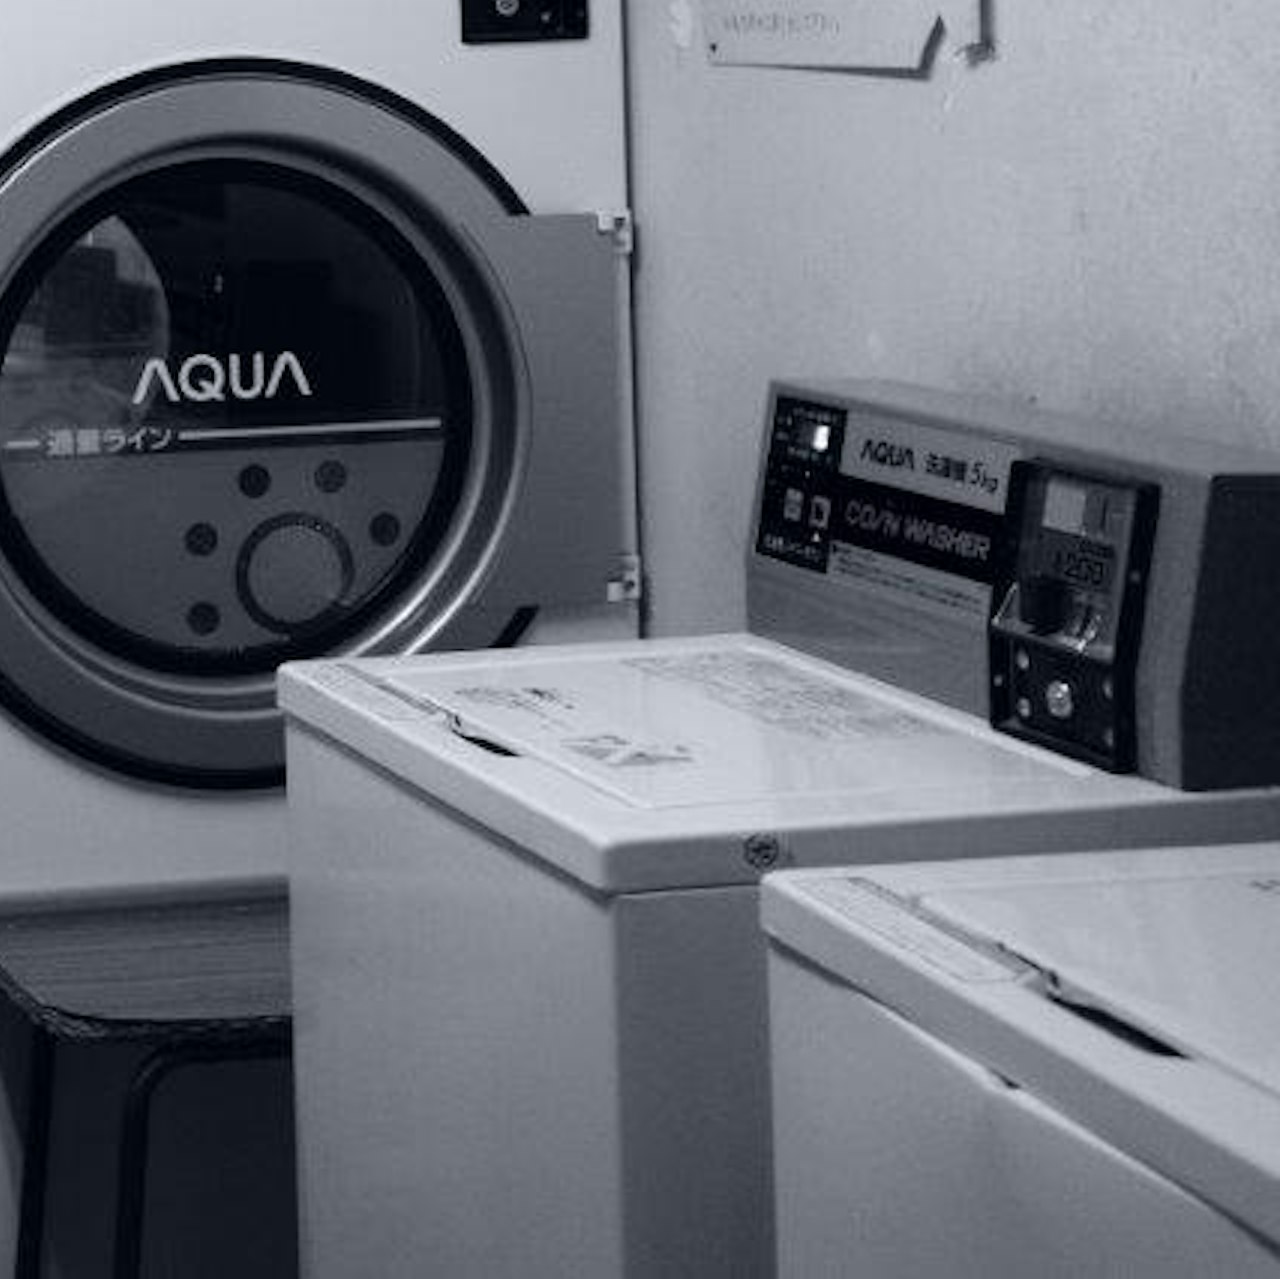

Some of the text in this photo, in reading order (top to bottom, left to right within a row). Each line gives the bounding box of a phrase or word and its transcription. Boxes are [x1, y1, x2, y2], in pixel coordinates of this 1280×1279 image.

[131, 349, 313, 407] AQUA
[46, 425, 173, 458] 適量ライン
[860, 438, 915, 472] AQUA
[902, 513, 992, 562] WASHER
